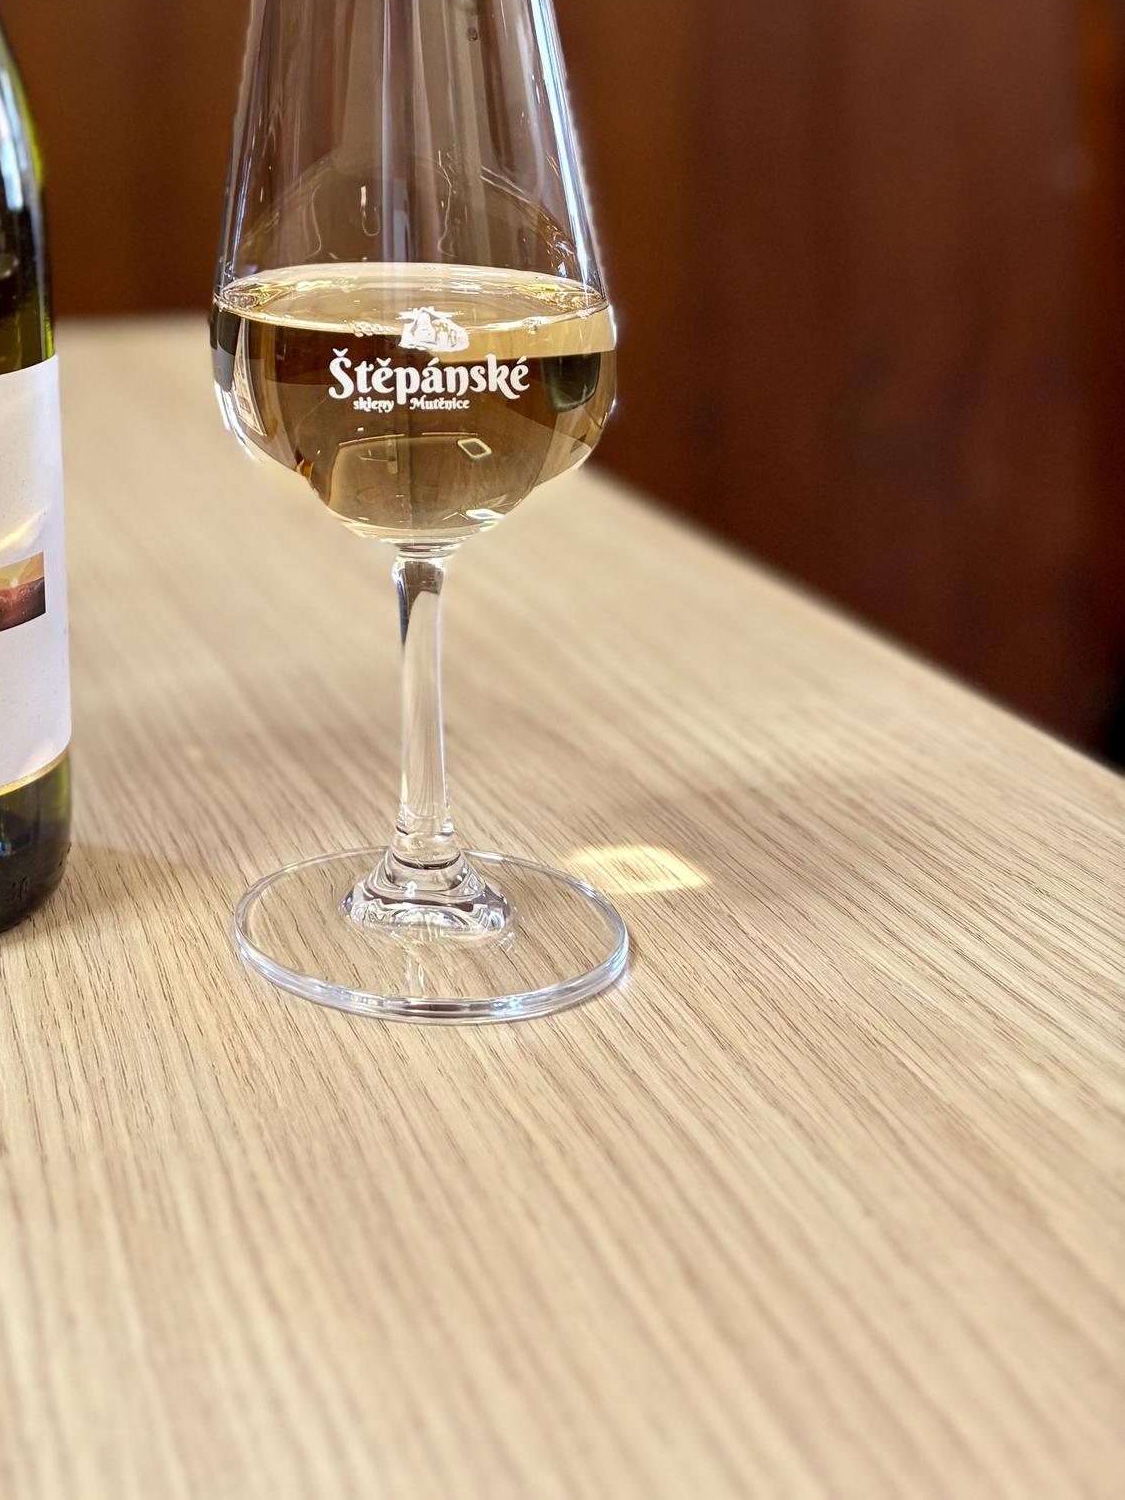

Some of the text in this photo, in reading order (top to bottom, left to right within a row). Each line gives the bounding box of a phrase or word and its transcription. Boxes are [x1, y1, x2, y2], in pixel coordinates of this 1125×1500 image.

[328, 347, 531, 405] Štěpánské
[353, 394, 471, 413] sklepy Mutěnice
